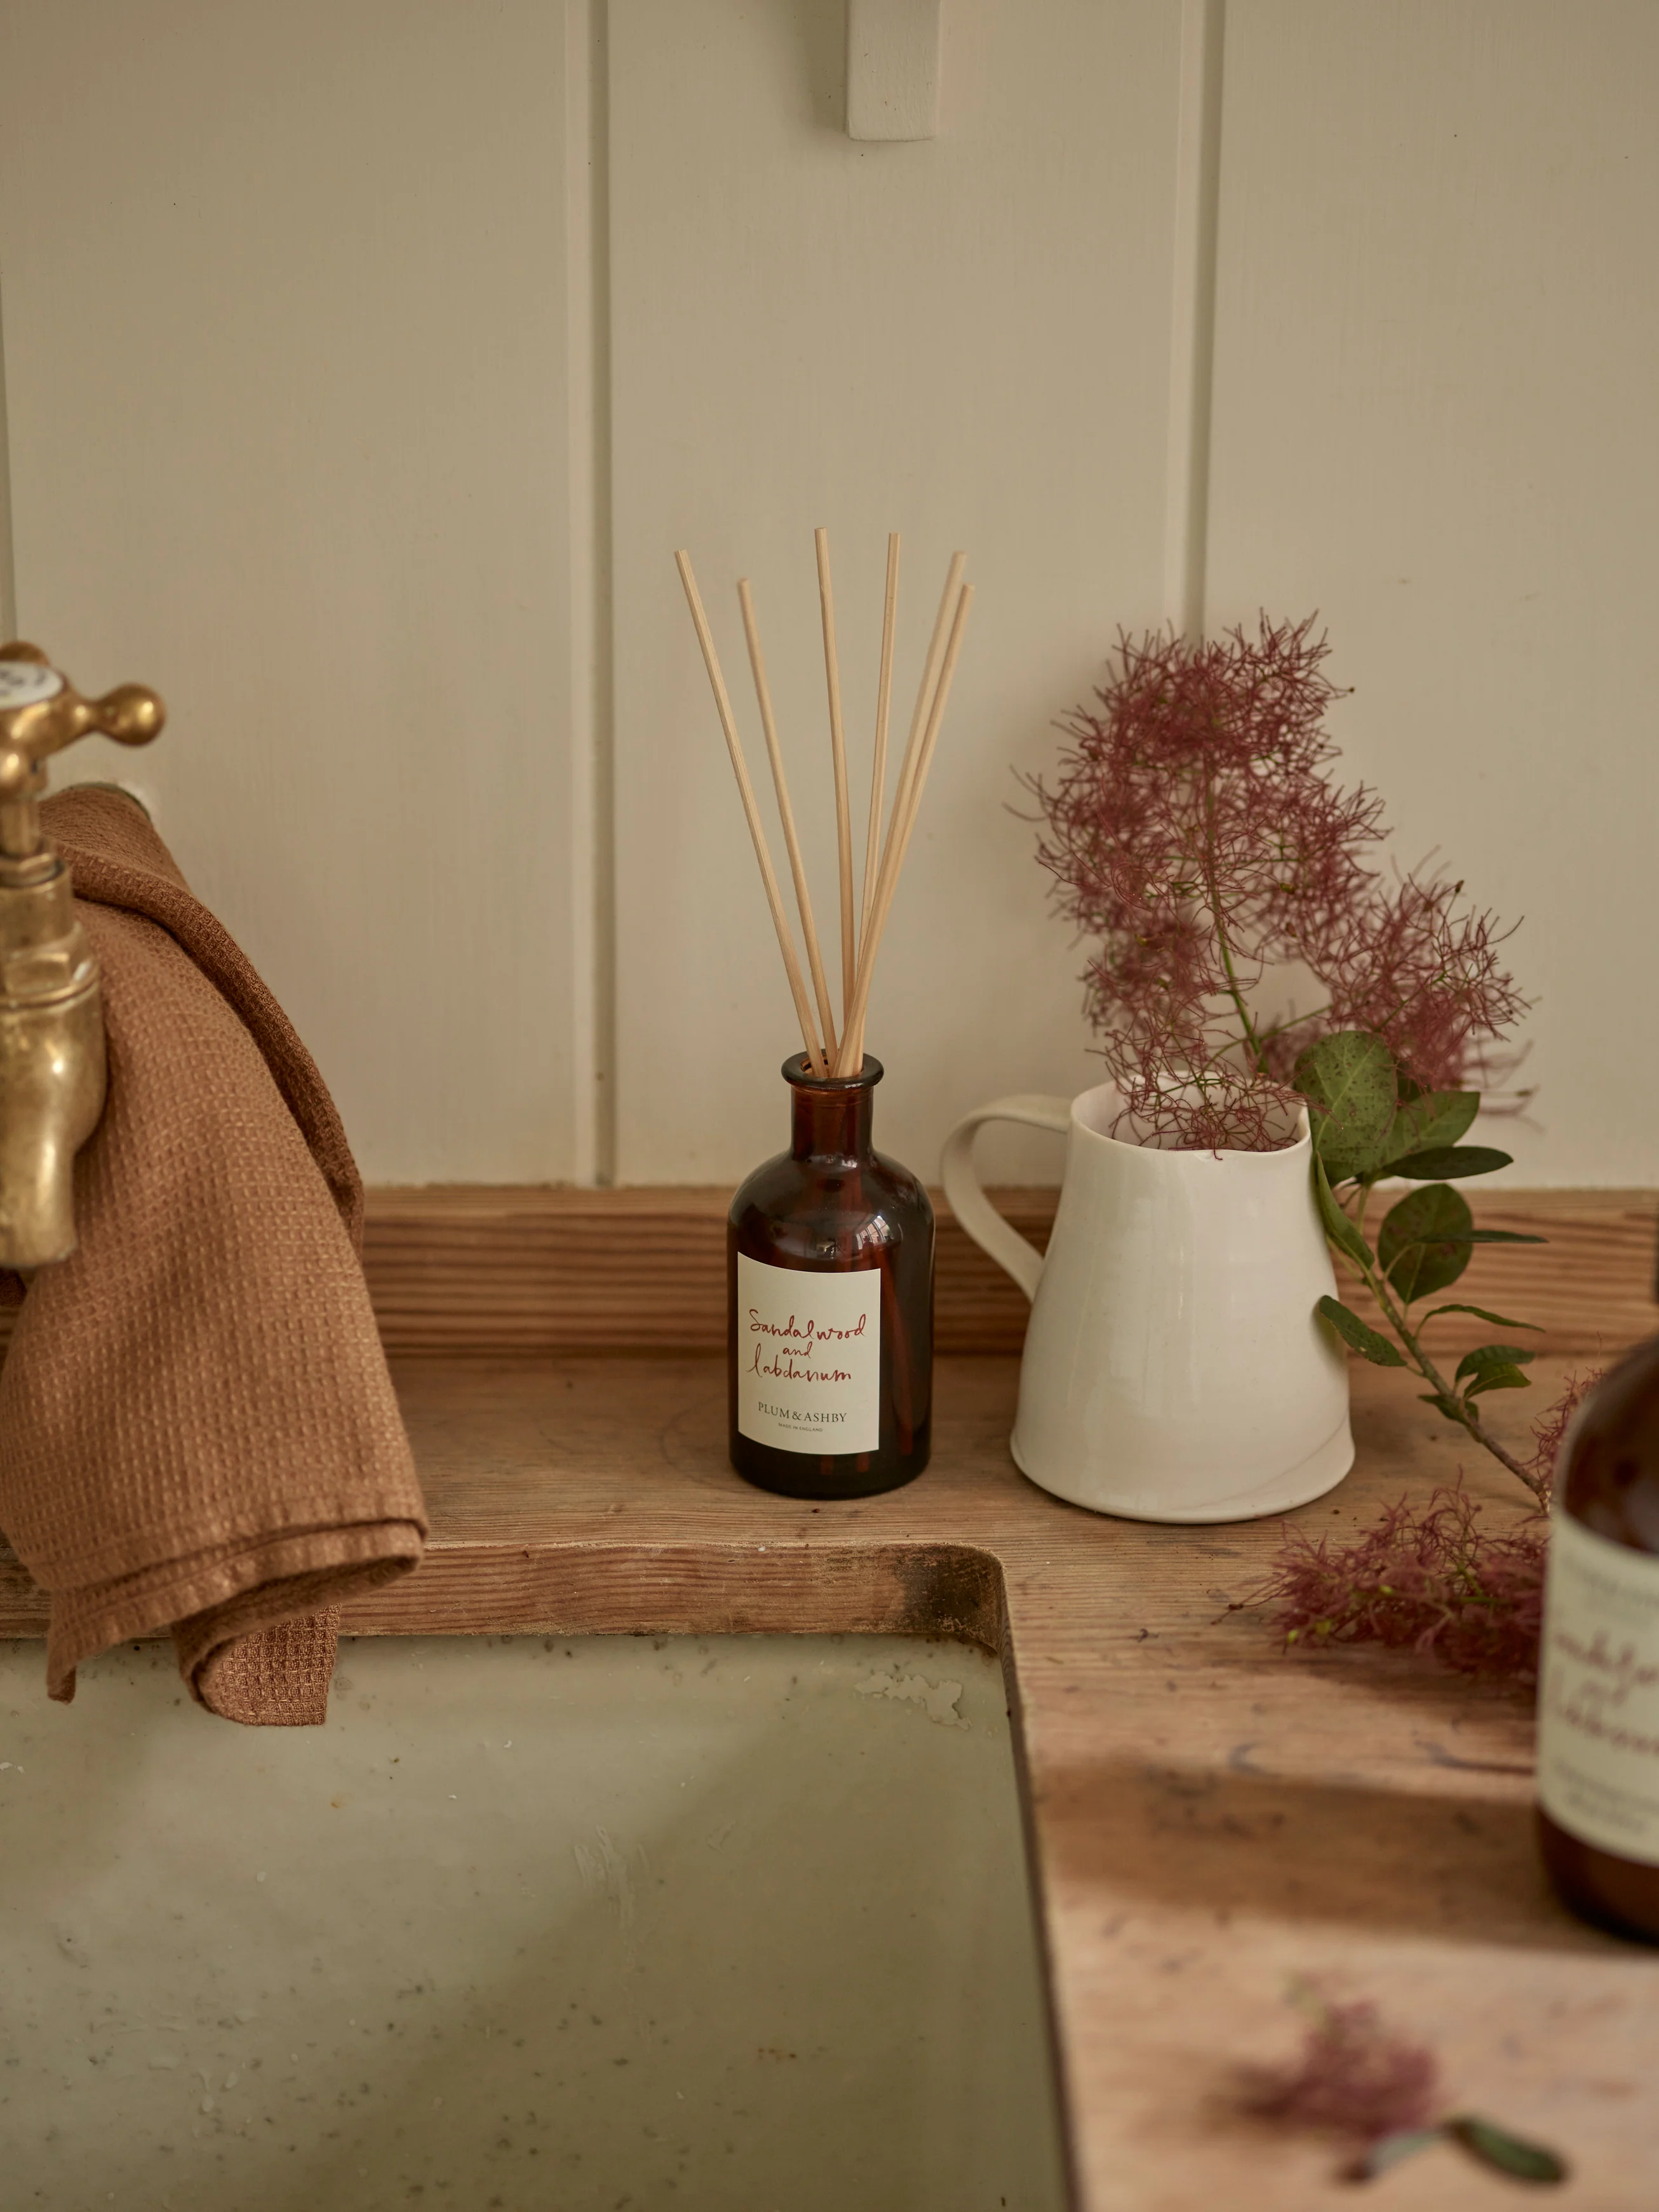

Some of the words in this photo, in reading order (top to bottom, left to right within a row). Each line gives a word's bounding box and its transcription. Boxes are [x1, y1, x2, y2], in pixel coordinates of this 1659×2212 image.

[749, 1309, 866, 1340] Sandalwood
[746, 1342, 851, 1382] labdanum
[782, 1341, 812, 1359] and
